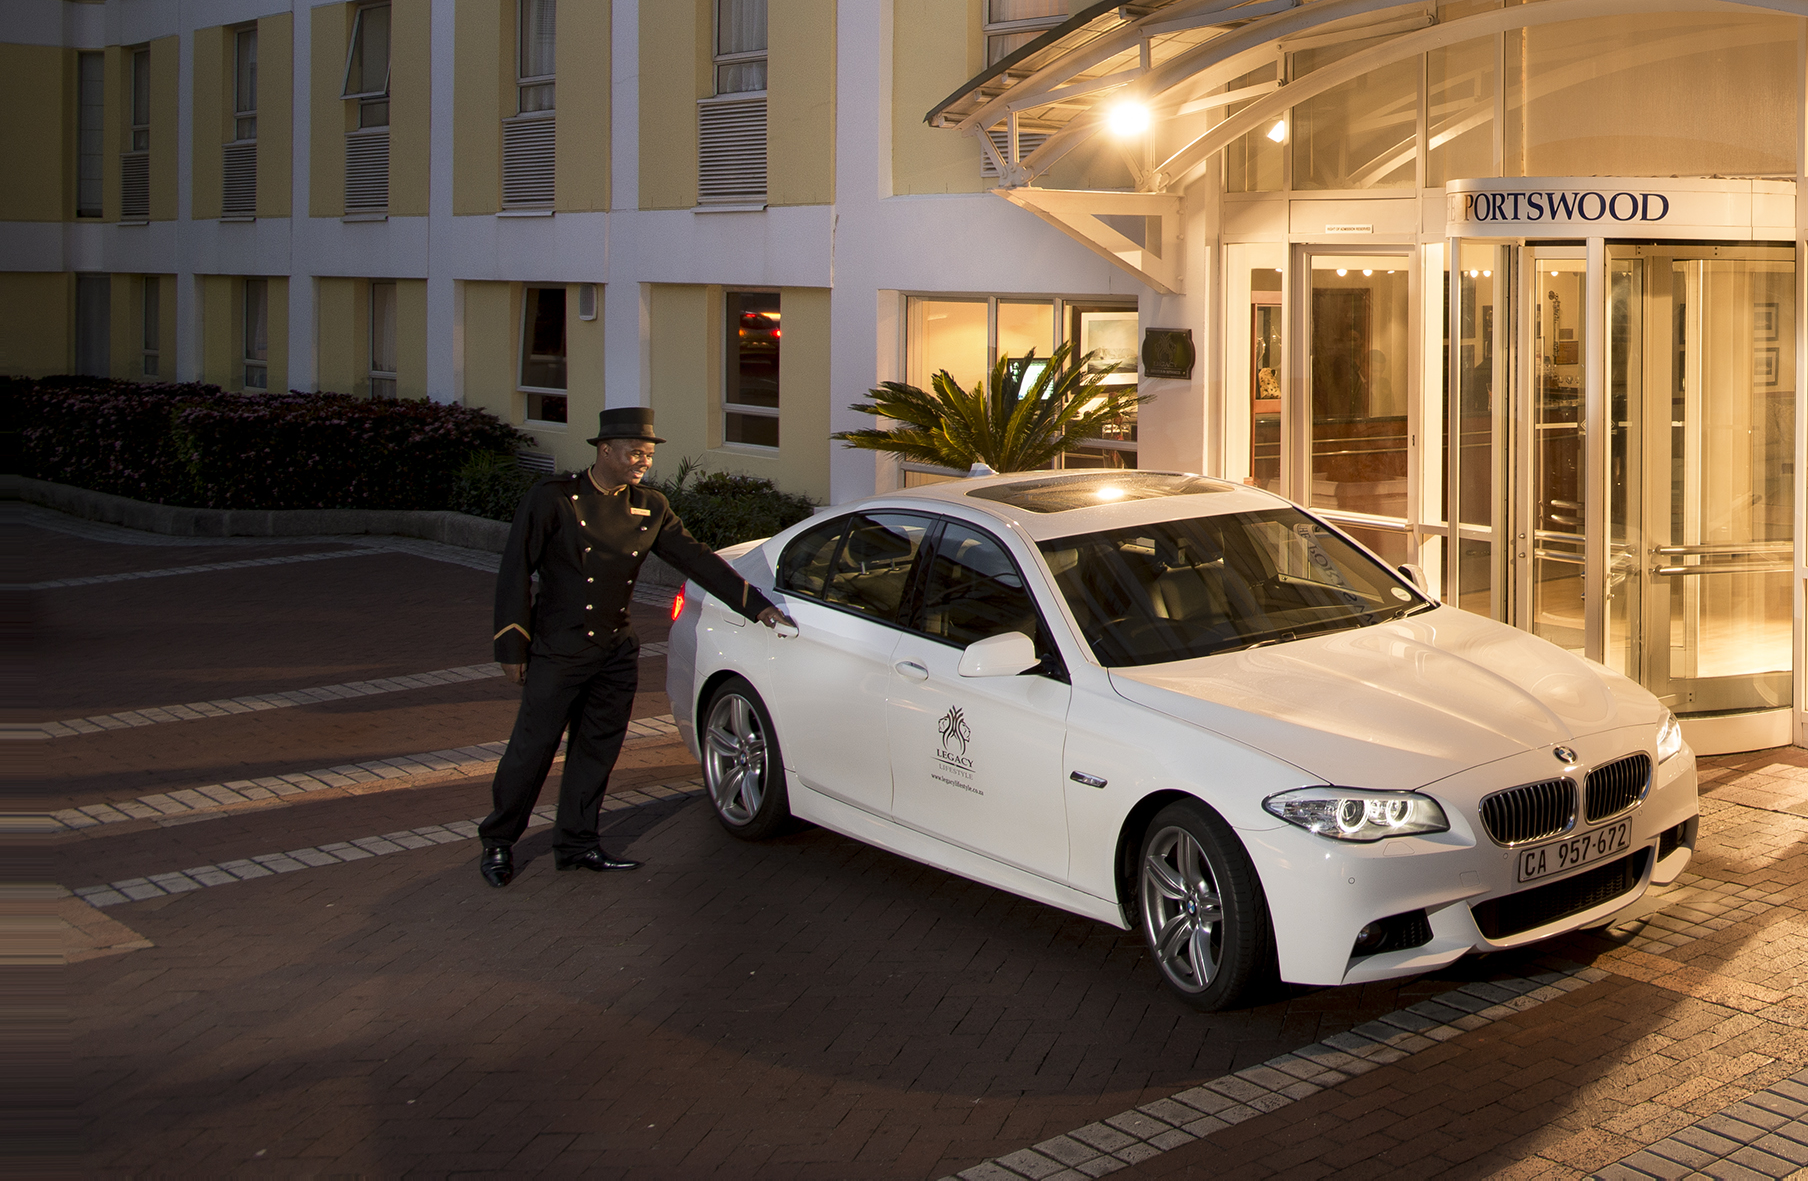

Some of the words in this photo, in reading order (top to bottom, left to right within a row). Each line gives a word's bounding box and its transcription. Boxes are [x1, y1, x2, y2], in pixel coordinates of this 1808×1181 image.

[1464, 192, 1670, 222] PORTSWOOD
[936, 748, 974, 767] LEGACY
[938, 763, 974, 780] LIFESTYLE
[1525, 849, 1547, 876] CA
